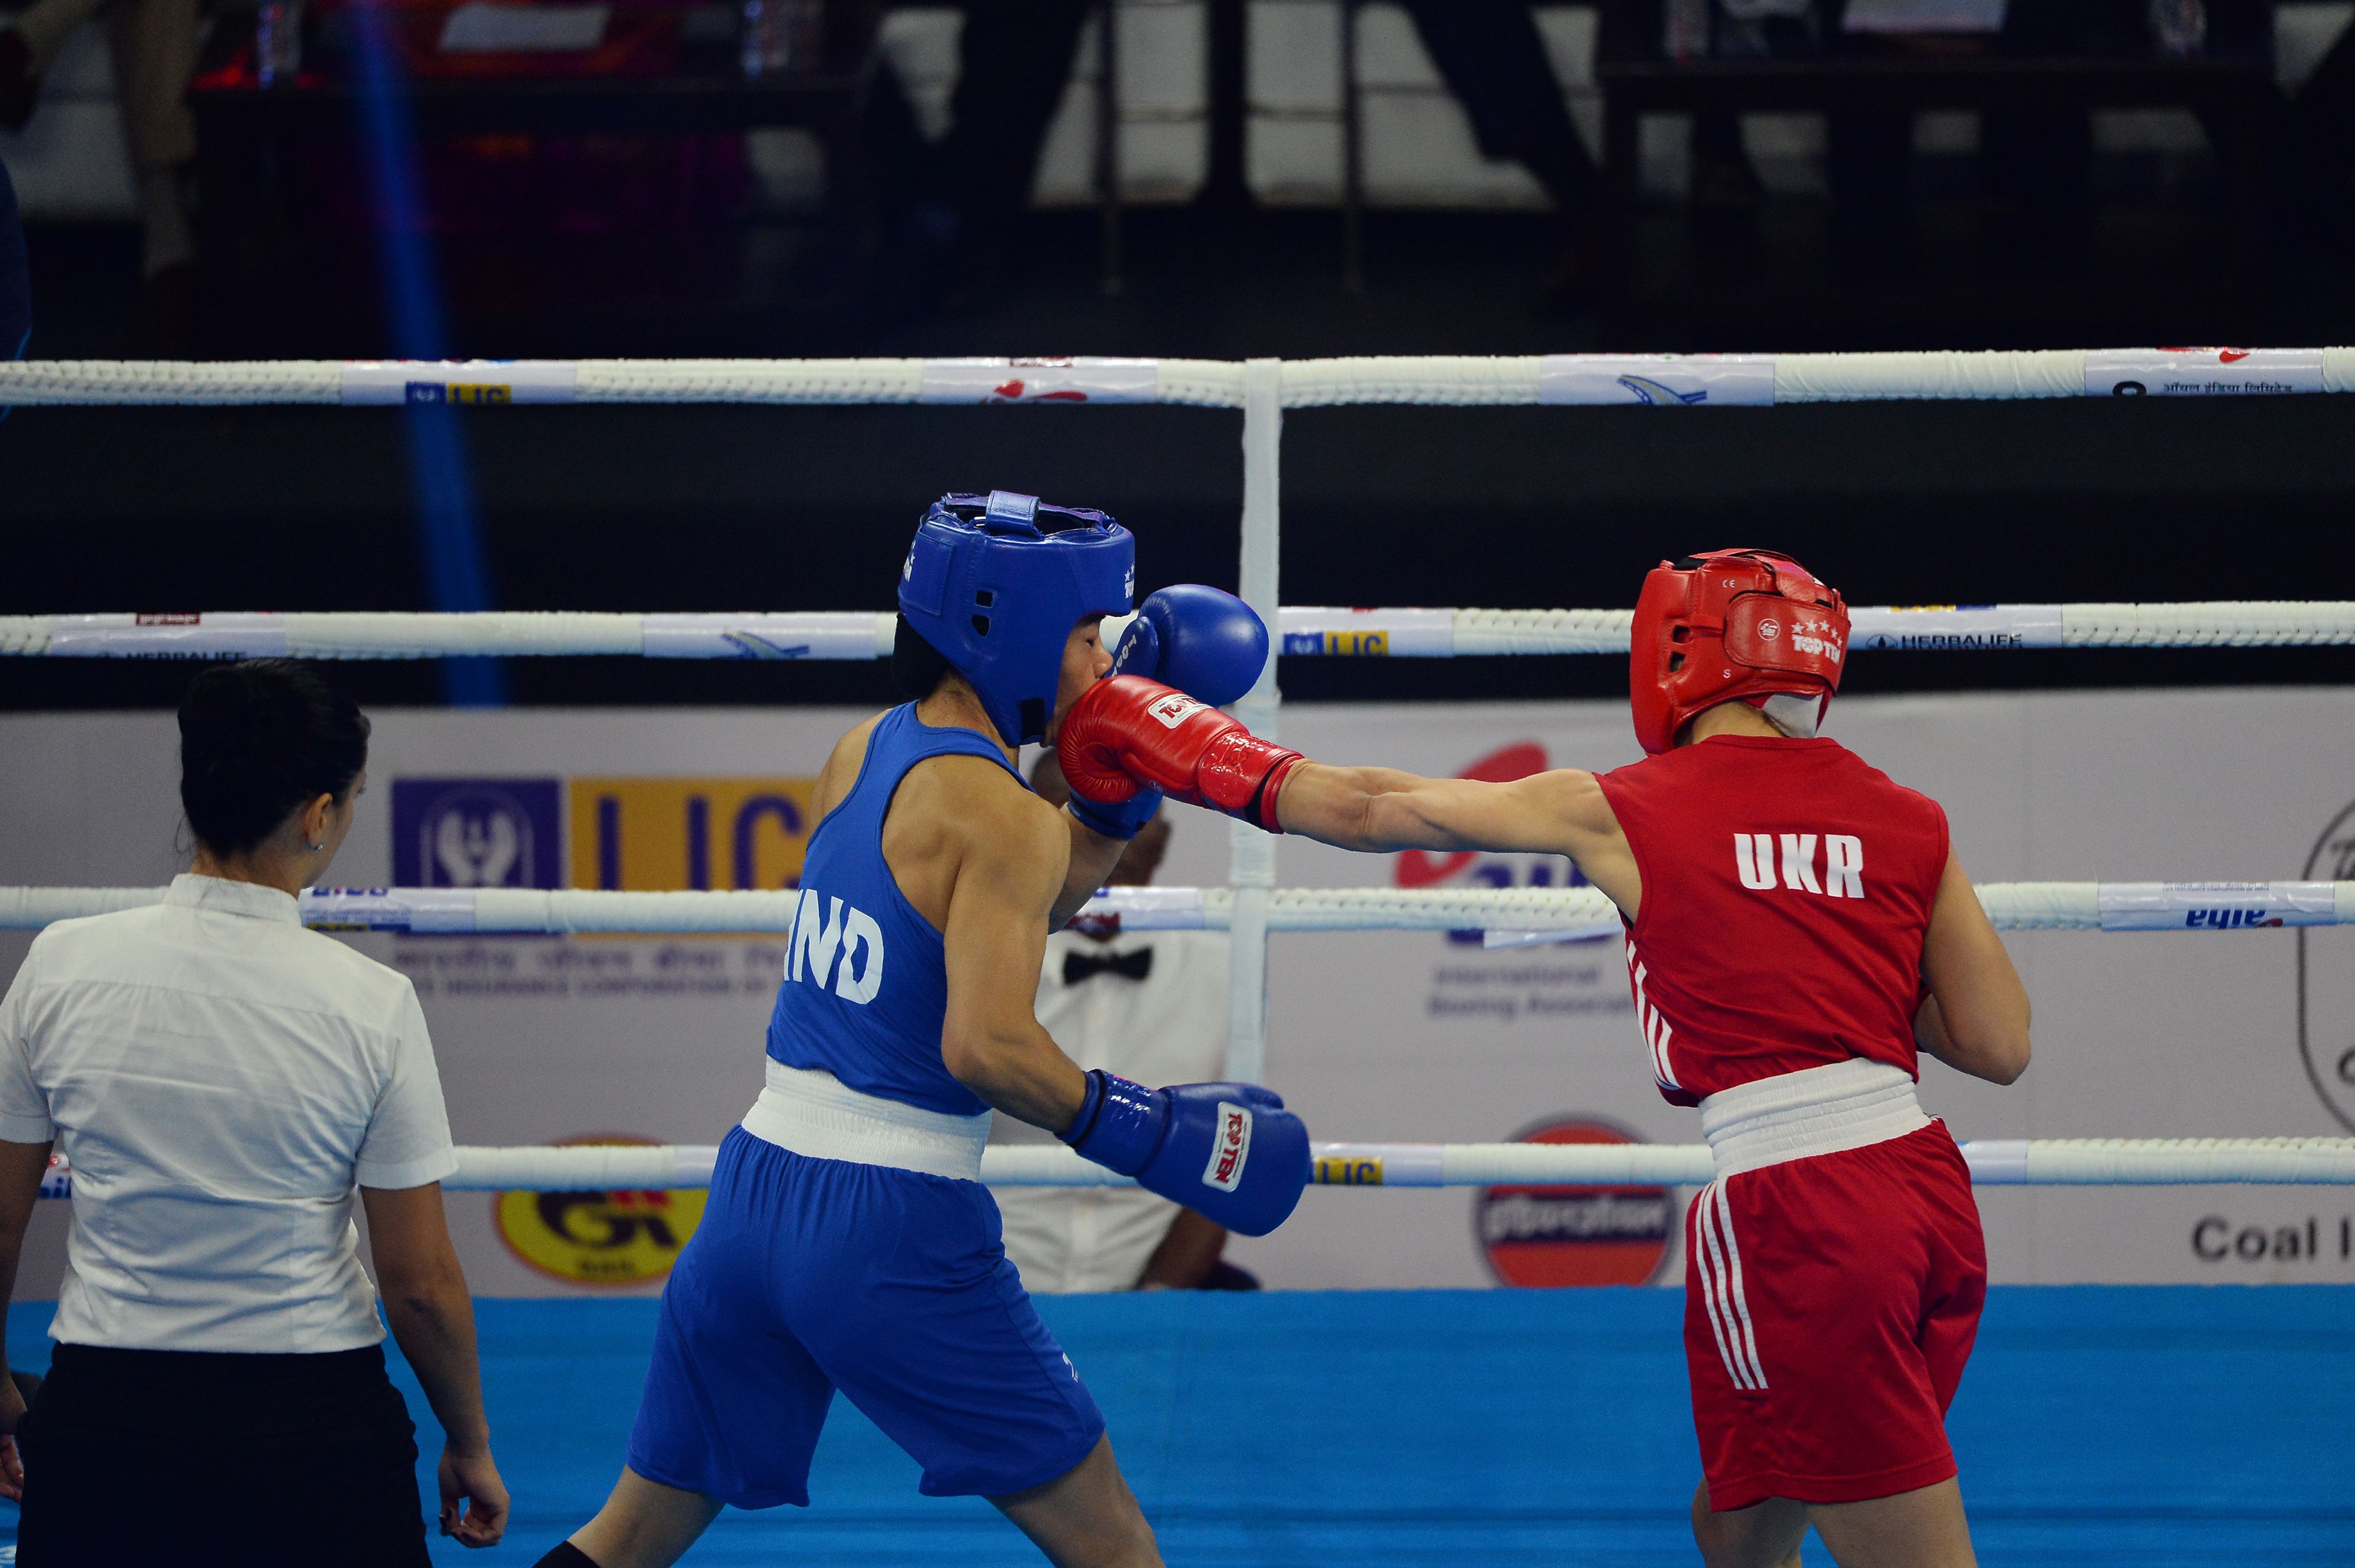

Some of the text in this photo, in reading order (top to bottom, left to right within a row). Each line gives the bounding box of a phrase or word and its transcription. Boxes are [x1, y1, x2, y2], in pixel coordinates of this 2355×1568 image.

[1723, 579, 1735, 588] CE
[1792, 634, 1824, 655] TOP
[1734, 833, 1865, 898] UKR
[784, 889, 884, 1005] IND
[2193, 1215, 2317, 1261] Coal
